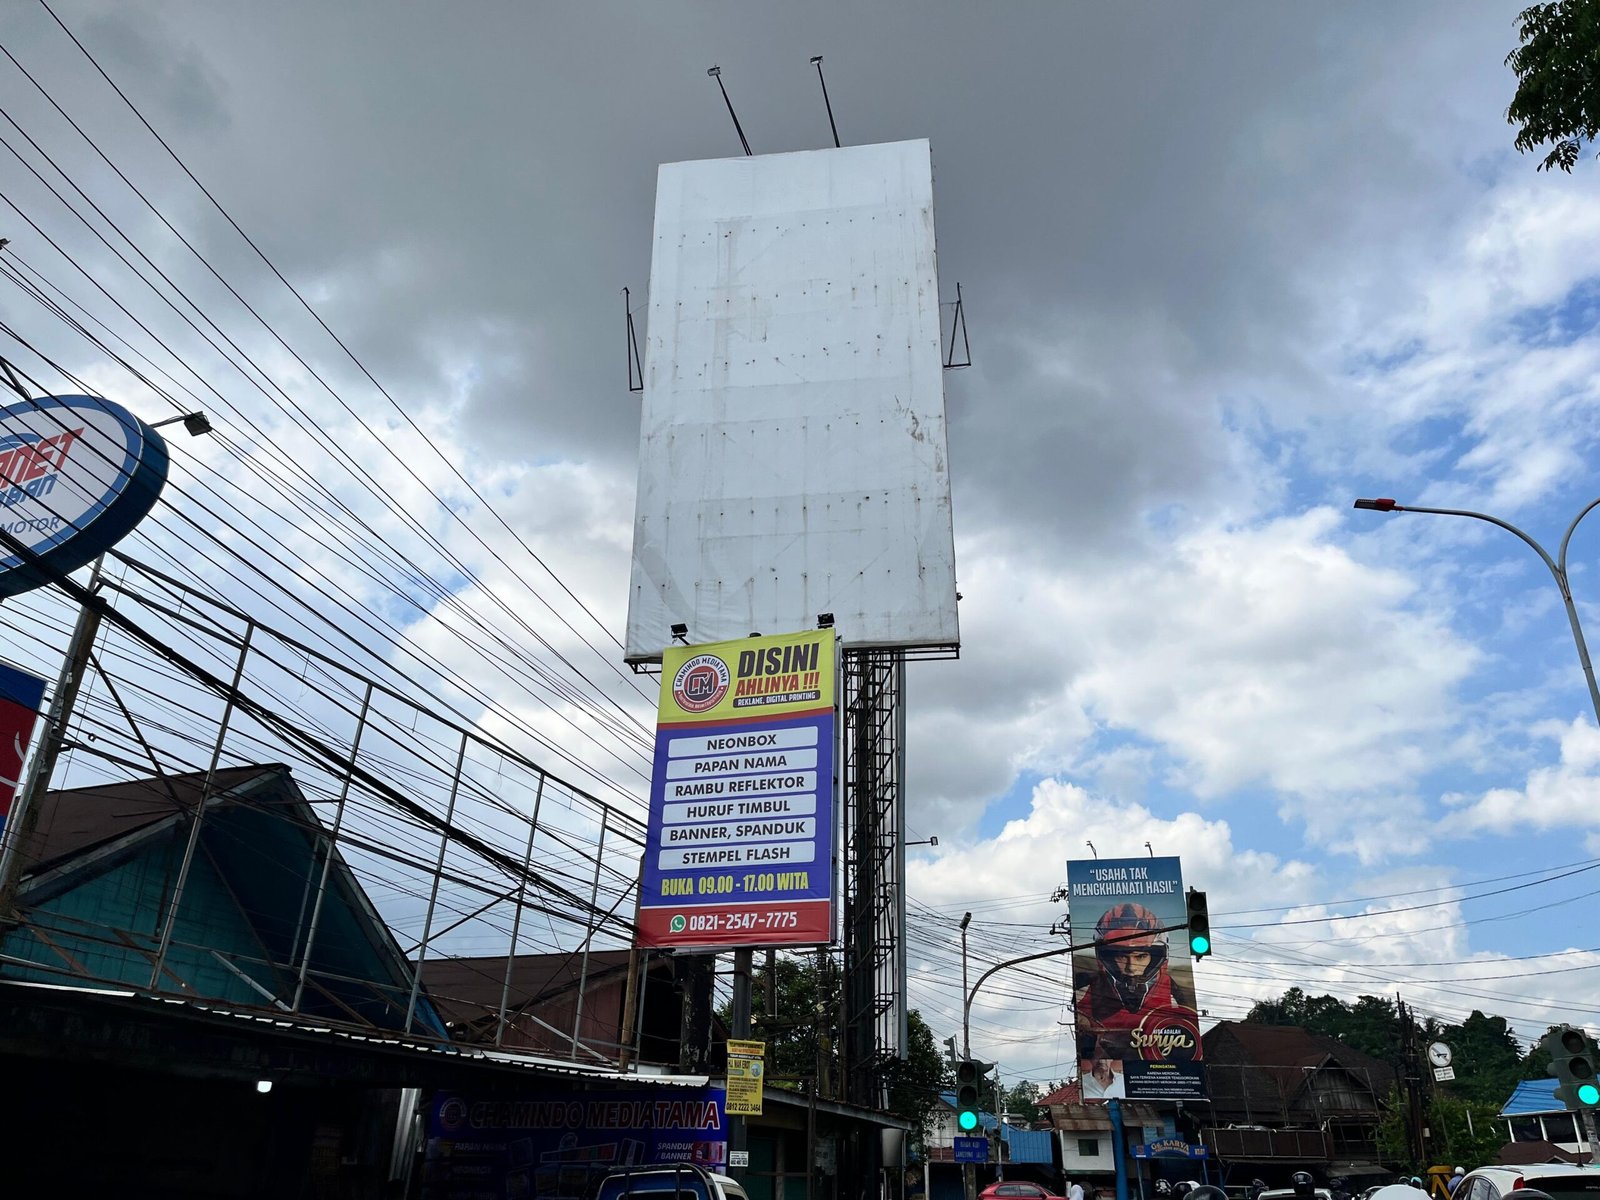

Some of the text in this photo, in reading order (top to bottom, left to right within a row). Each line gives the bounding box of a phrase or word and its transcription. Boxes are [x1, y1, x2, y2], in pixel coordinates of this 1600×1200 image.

[737, 643, 820, 679] DISINI
[675, 657, 727, 687] CHAMINDO MEDIATAMA
[735, 672, 820, 697] AHLINYA !!!
[766, 694, 788, 704] DIGITAL
[788, 692, 816, 702] PRINTING
[707, 734, 777, 751] NEONBOX
[694, 755, 787, 773] PAPAN NAMA
[675, 776, 805, 797] RAMBU REFLEKTOR
[687, 800, 791, 818] HURUF TIMBUL
[669, 821, 806, 841] BANNER, SPANDUK
[682, 847, 790, 865] STEMPEL FLASH
[1130, 867, 1148, 880] TAK
[661, 877, 694, 896] BUKA
[698, 875, 734, 894] 09.00
[743, 873, 774, 892] 17.00
[777, 872, 809, 890] WITA
[1073, 881, 1144, 897] MENGKHIANATI
[689, 911, 798, 931] 0821-2547-7775
[1129, 1027, 1194, 1057] Surya
[469, 1101, 585, 1130] CHAMINDO
[586, 1100, 720, 1130] MEDIATAMA
[657, 1142, 694, 1151] SPANDUK
[1162, 1139, 1190, 1152] KARYA
[660, 1152, 692, 1161] BANNER
